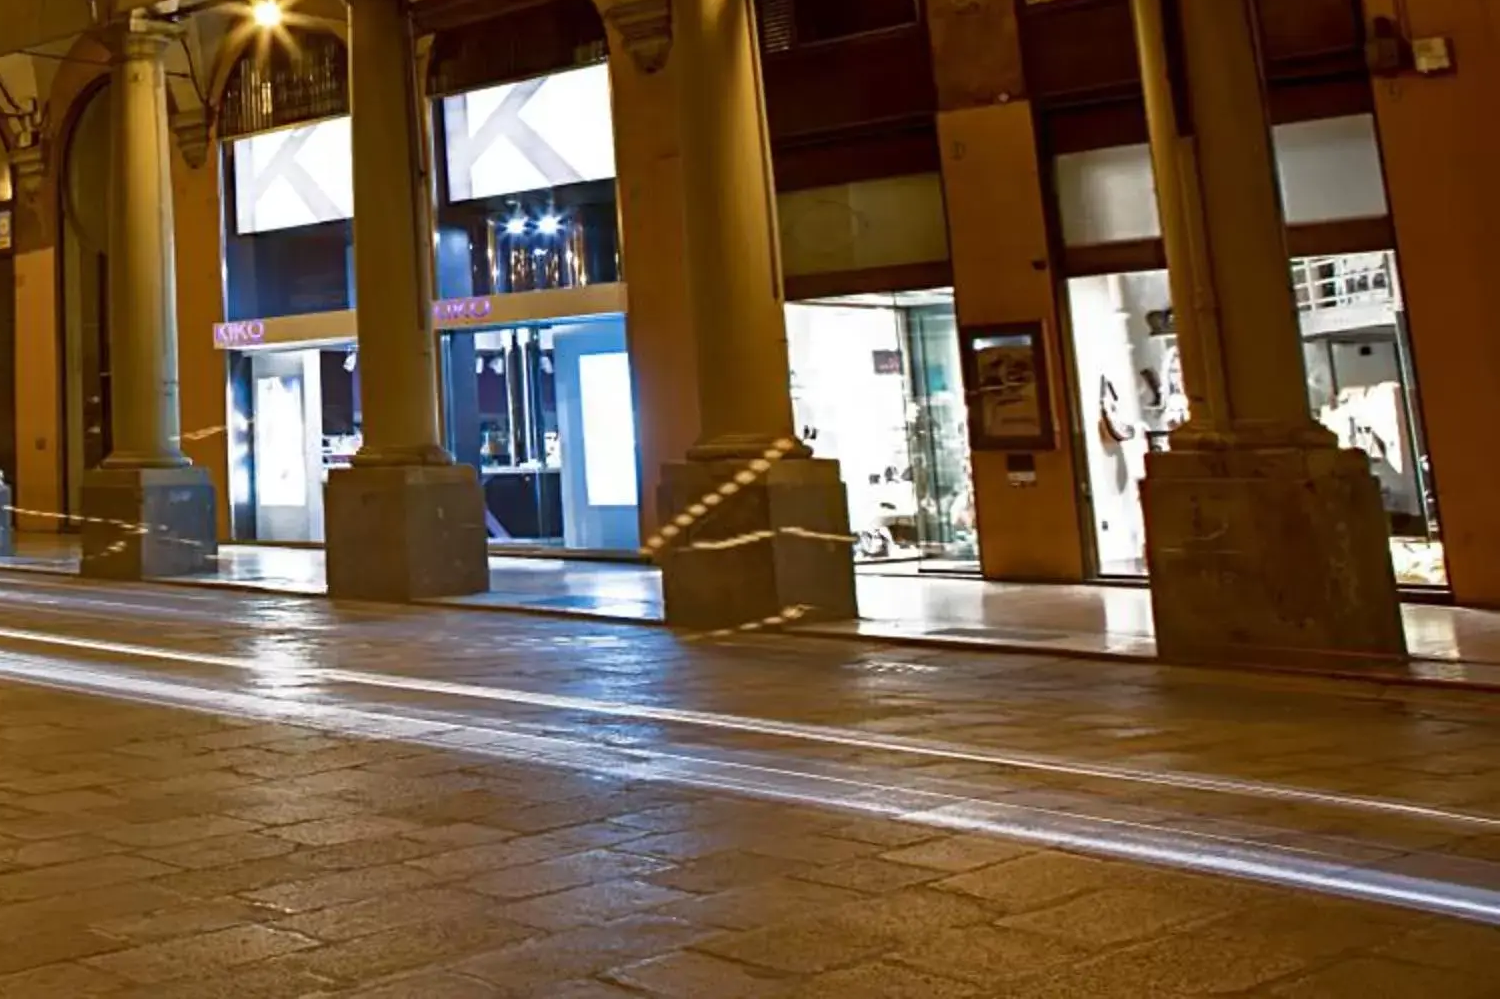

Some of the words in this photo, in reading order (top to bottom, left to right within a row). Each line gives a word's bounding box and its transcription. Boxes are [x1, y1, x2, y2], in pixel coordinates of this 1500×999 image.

[234, 125, 343, 233] K
[443, 77, 585, 201] K
[215, 320, 264, 343] KIKO
